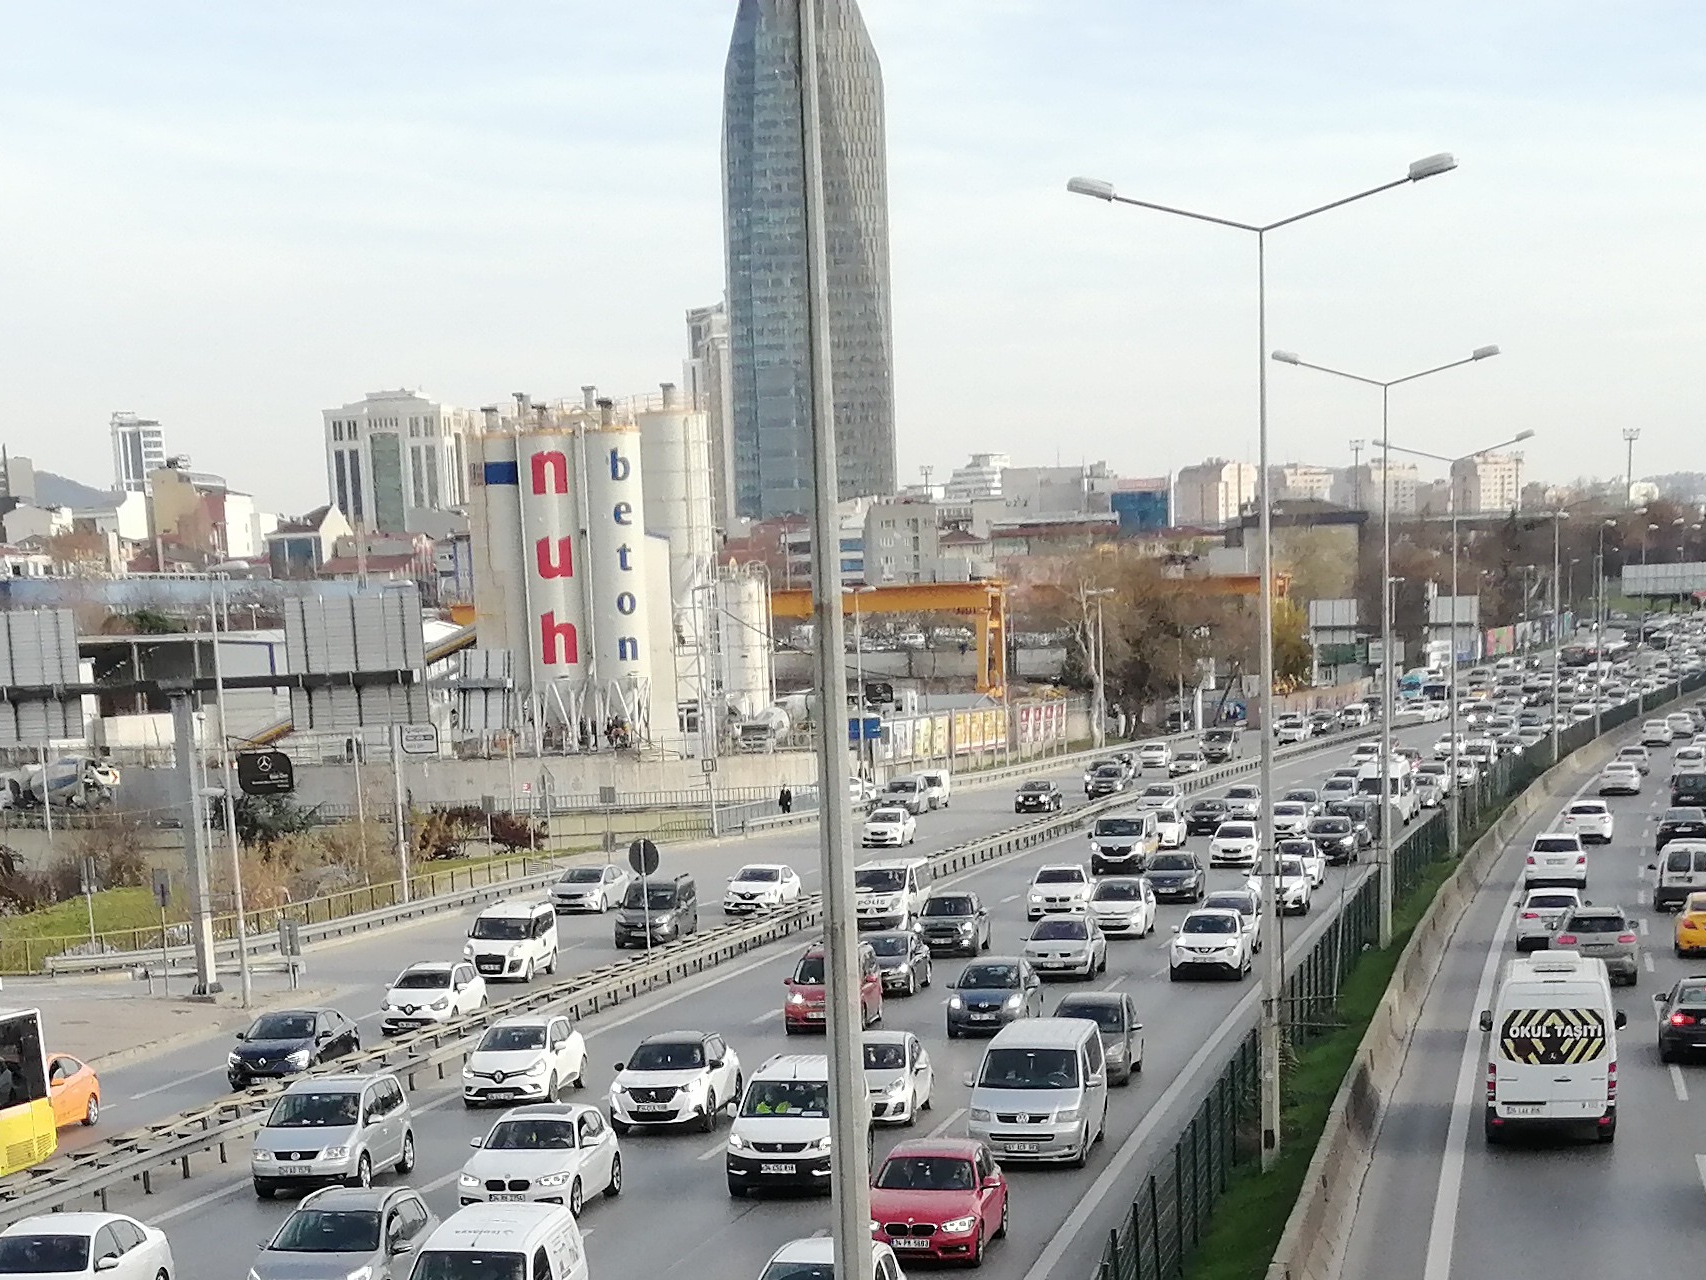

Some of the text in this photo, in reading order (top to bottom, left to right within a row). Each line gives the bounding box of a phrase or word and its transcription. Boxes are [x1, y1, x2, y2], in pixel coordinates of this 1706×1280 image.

[531, 450, 579, 665] nuh
[609, 448, 639, 661] beton
[1509, 1024, 1551, 1039] OKUL
